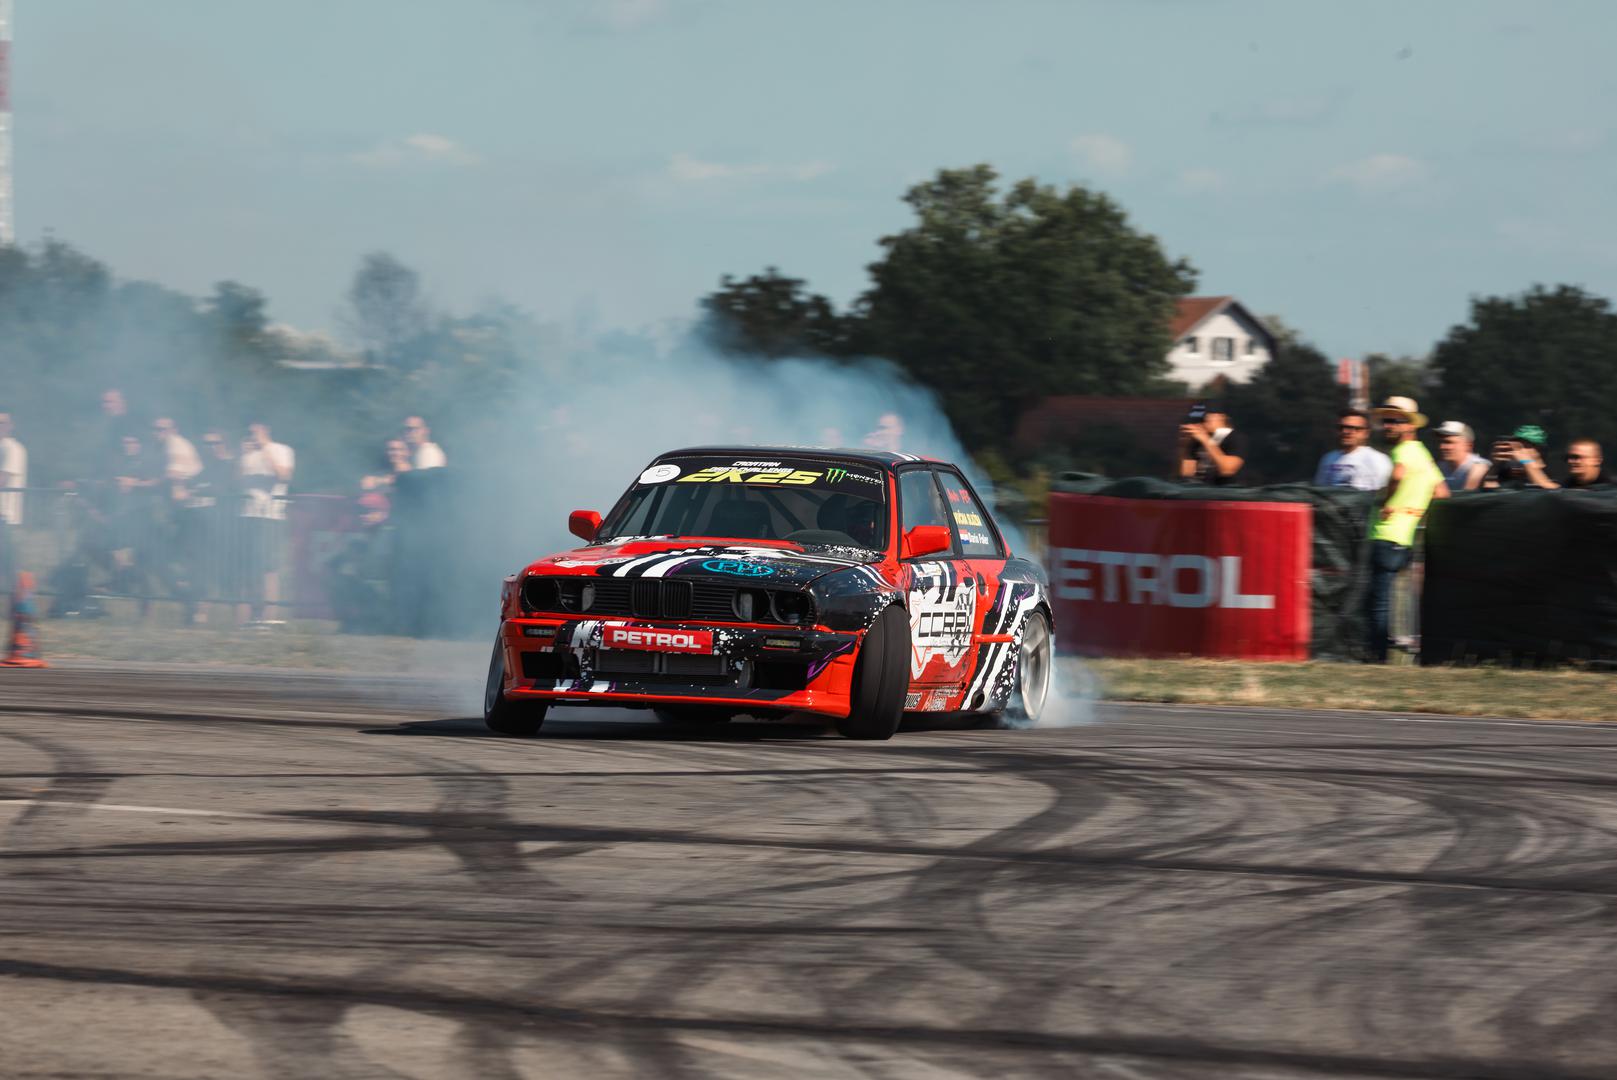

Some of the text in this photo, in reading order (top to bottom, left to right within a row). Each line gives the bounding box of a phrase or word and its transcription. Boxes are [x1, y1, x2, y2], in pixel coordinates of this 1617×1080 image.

[676, 468, 823, 485] 2K25
[1050, 547, 1276, 609] ETROL
[613, 630, 702, 649] PETROL
